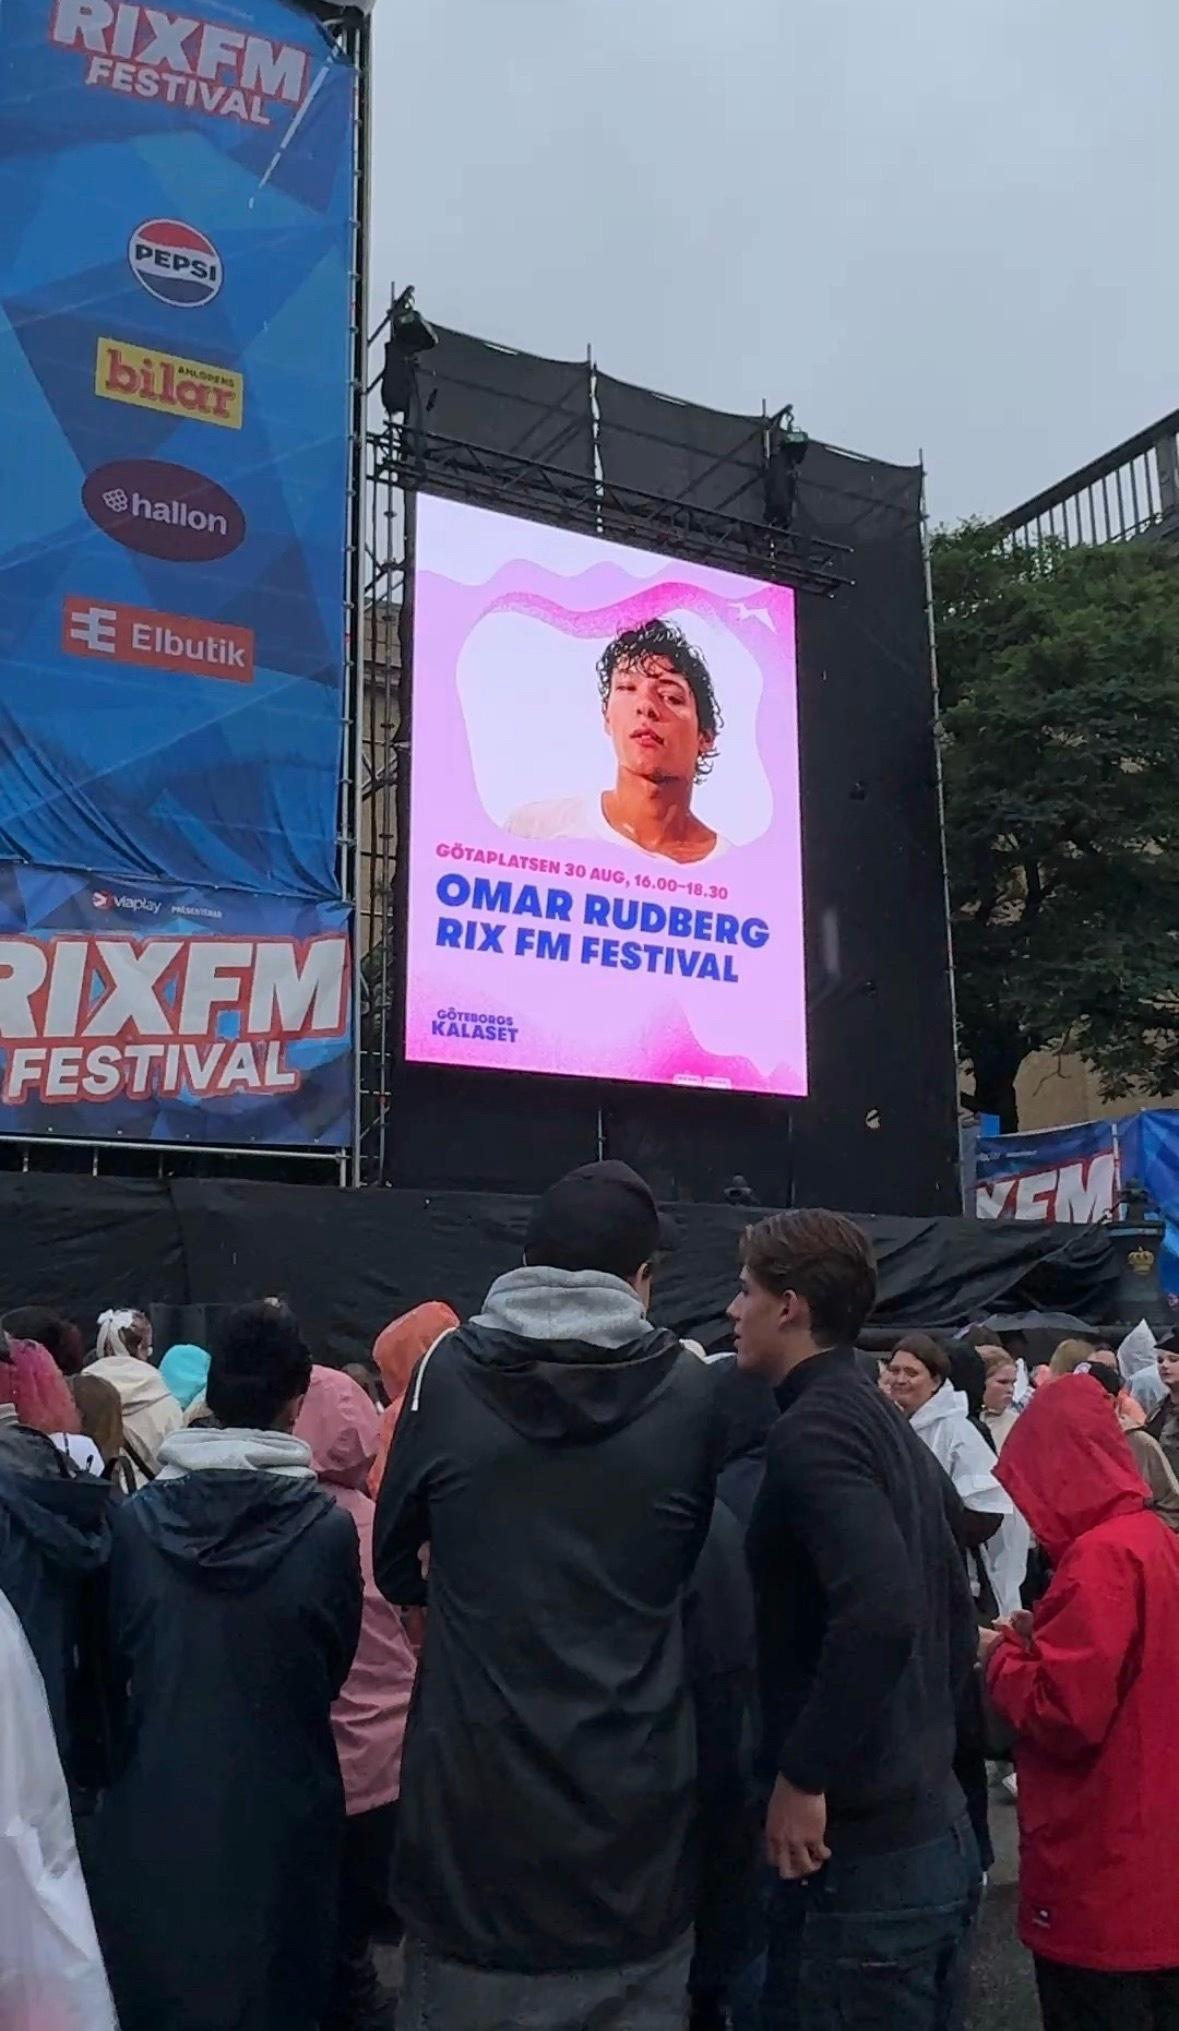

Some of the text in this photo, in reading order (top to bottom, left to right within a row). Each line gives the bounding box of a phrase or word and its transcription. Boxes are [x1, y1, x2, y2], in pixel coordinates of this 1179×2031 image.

[53, 0, 307, 102] RIXFM
[86, 59, 271, 126] FESTIVAL
[134, 243, 217, 282] PEPSI
[105, 348, 236, 420] bilar
[131, 492, 227, 536] hallon
[131, 622, 246, 668] Elbutik
[435, 843, 561, 875] GÖTAPLATSEN
[564, 862, 587, 879] 30
[590, 868, 631, 888] AUG,
[113, 895, 163, 915] viaplay
[436, 873, 770, 949] OMAR RUDBERG
[436, 916, 740, 983] RIX FM FESTIVAL
[0, 938, 347, 1038] RIXFM
[431, 1020, 519, 1043] KALASET
[7, 1040, 296, 1098] FESTIVAL
